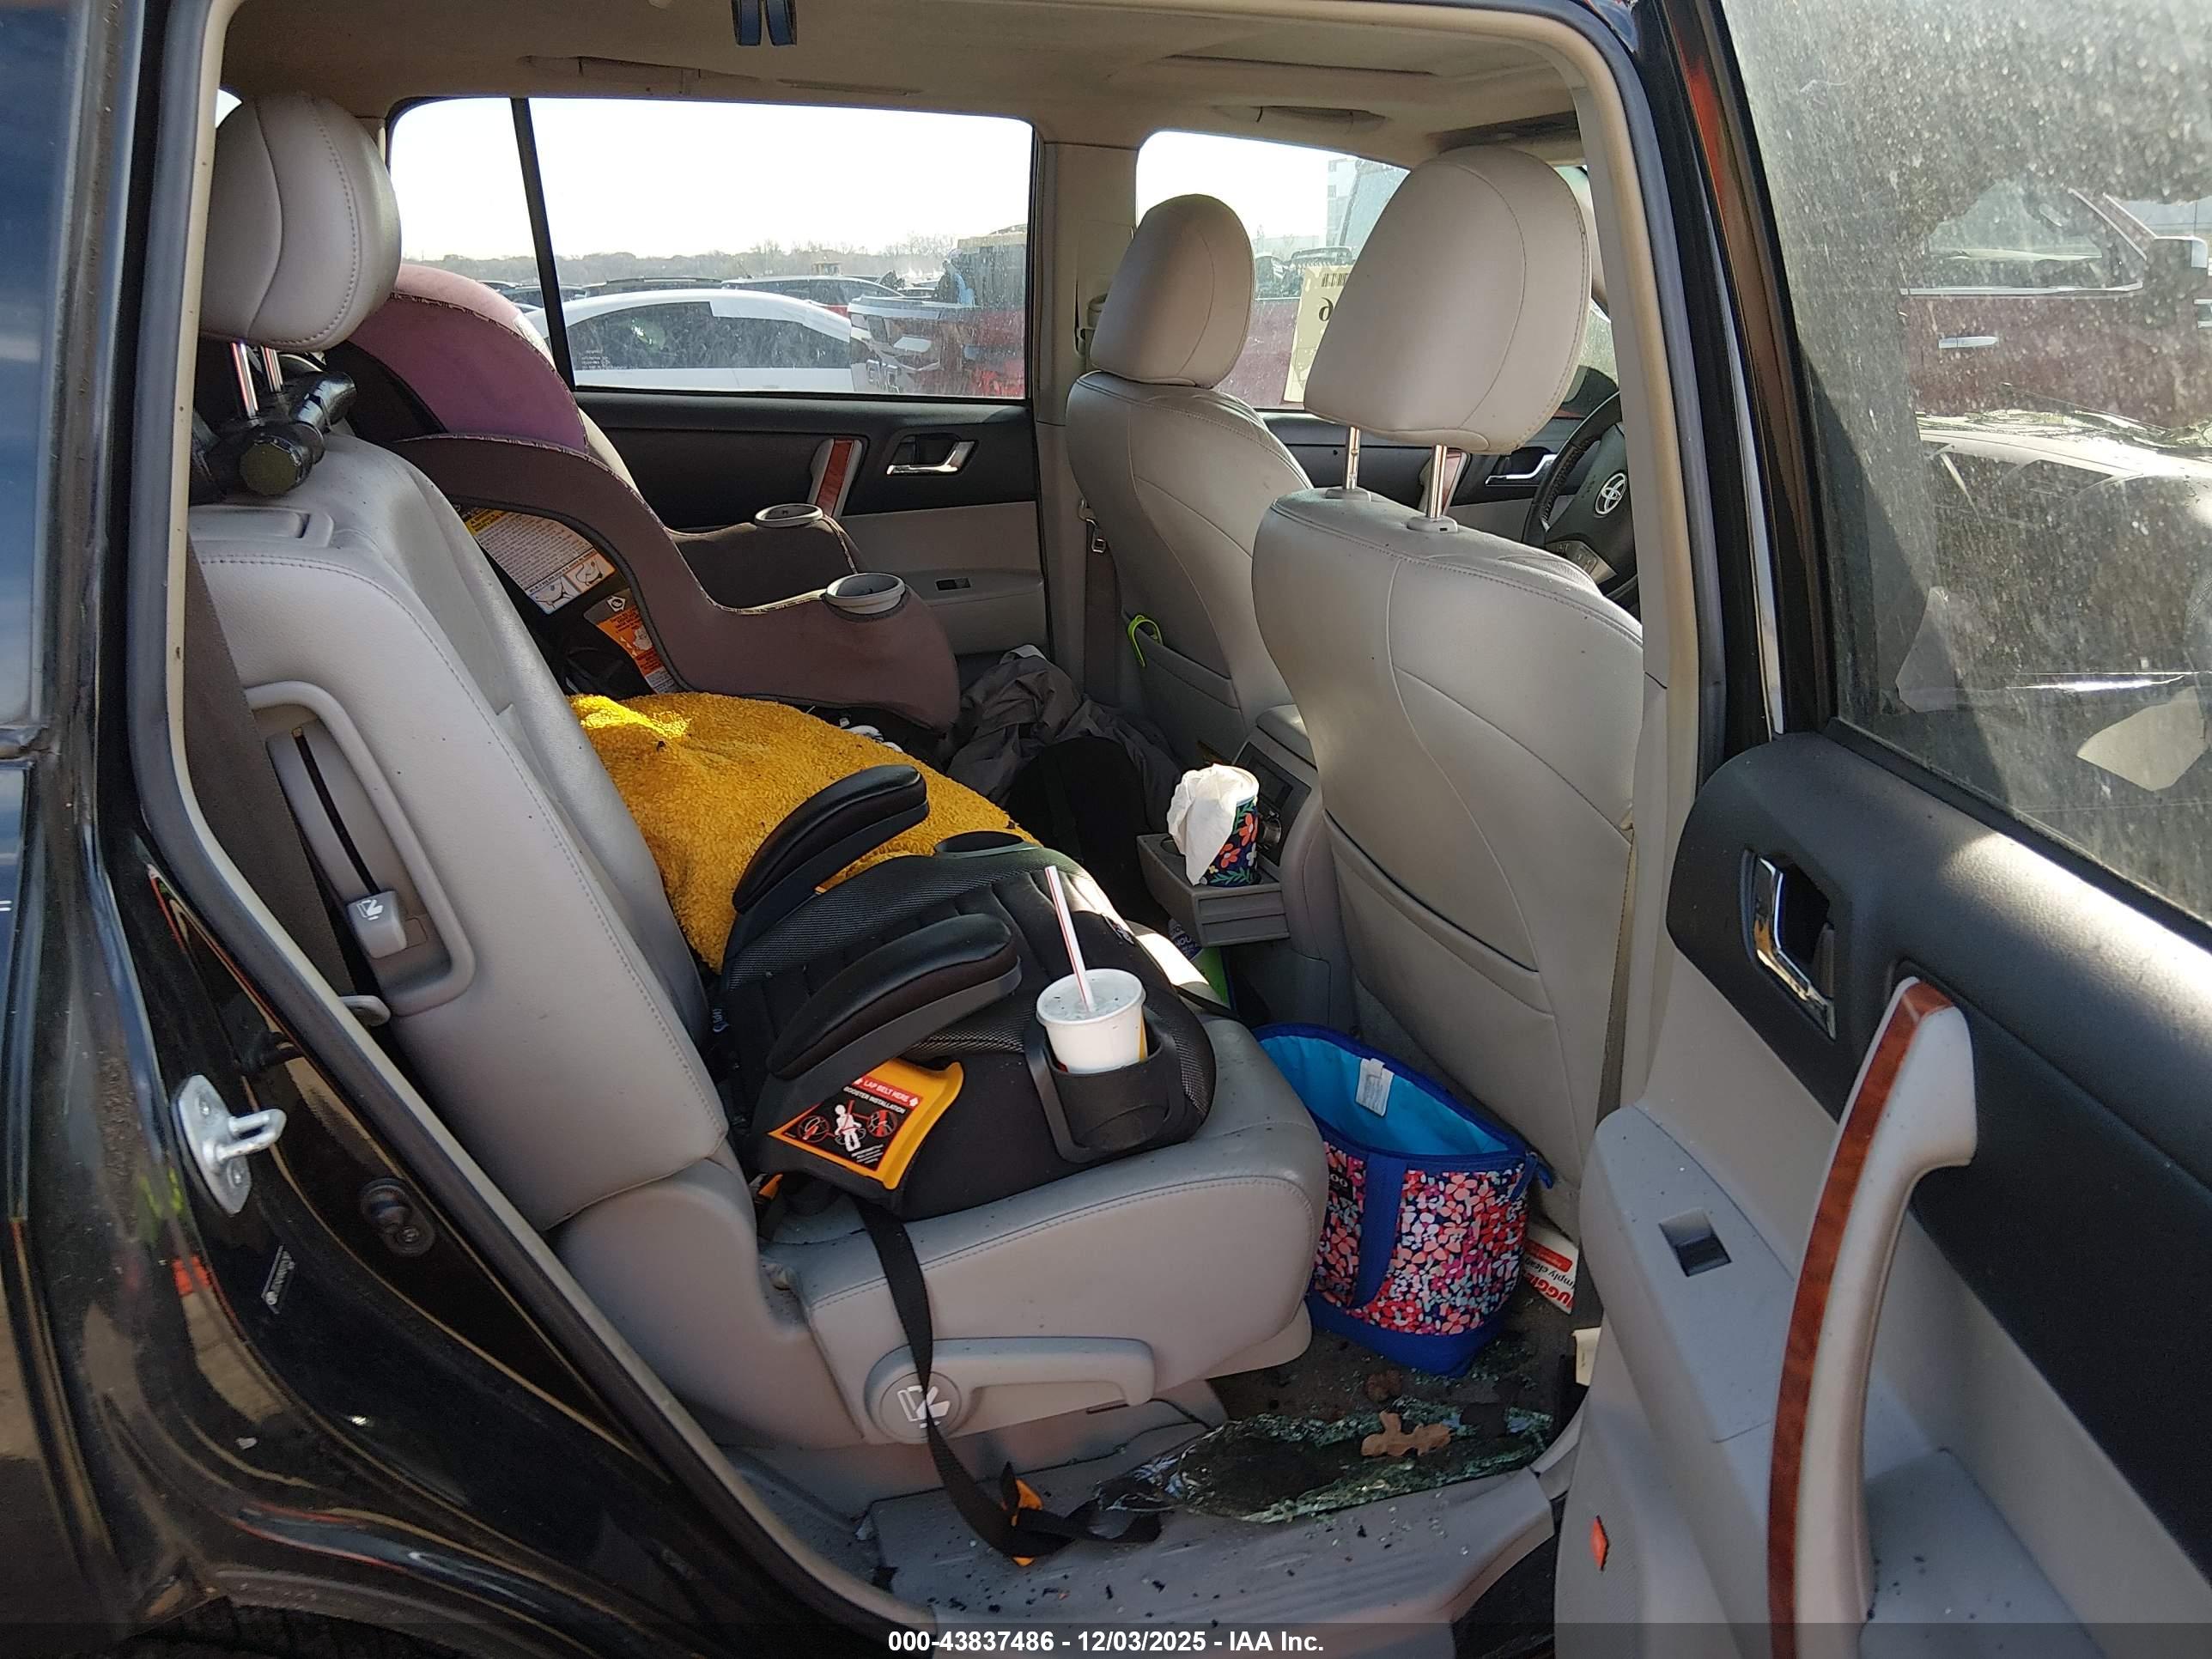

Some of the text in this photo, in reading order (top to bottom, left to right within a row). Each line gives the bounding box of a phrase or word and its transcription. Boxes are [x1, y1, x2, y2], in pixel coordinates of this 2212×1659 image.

[843, 1086, 906, 1114] BOOSTER INSTALLATION
[863, 1080, 910, 1102] LAP BELT HERE
